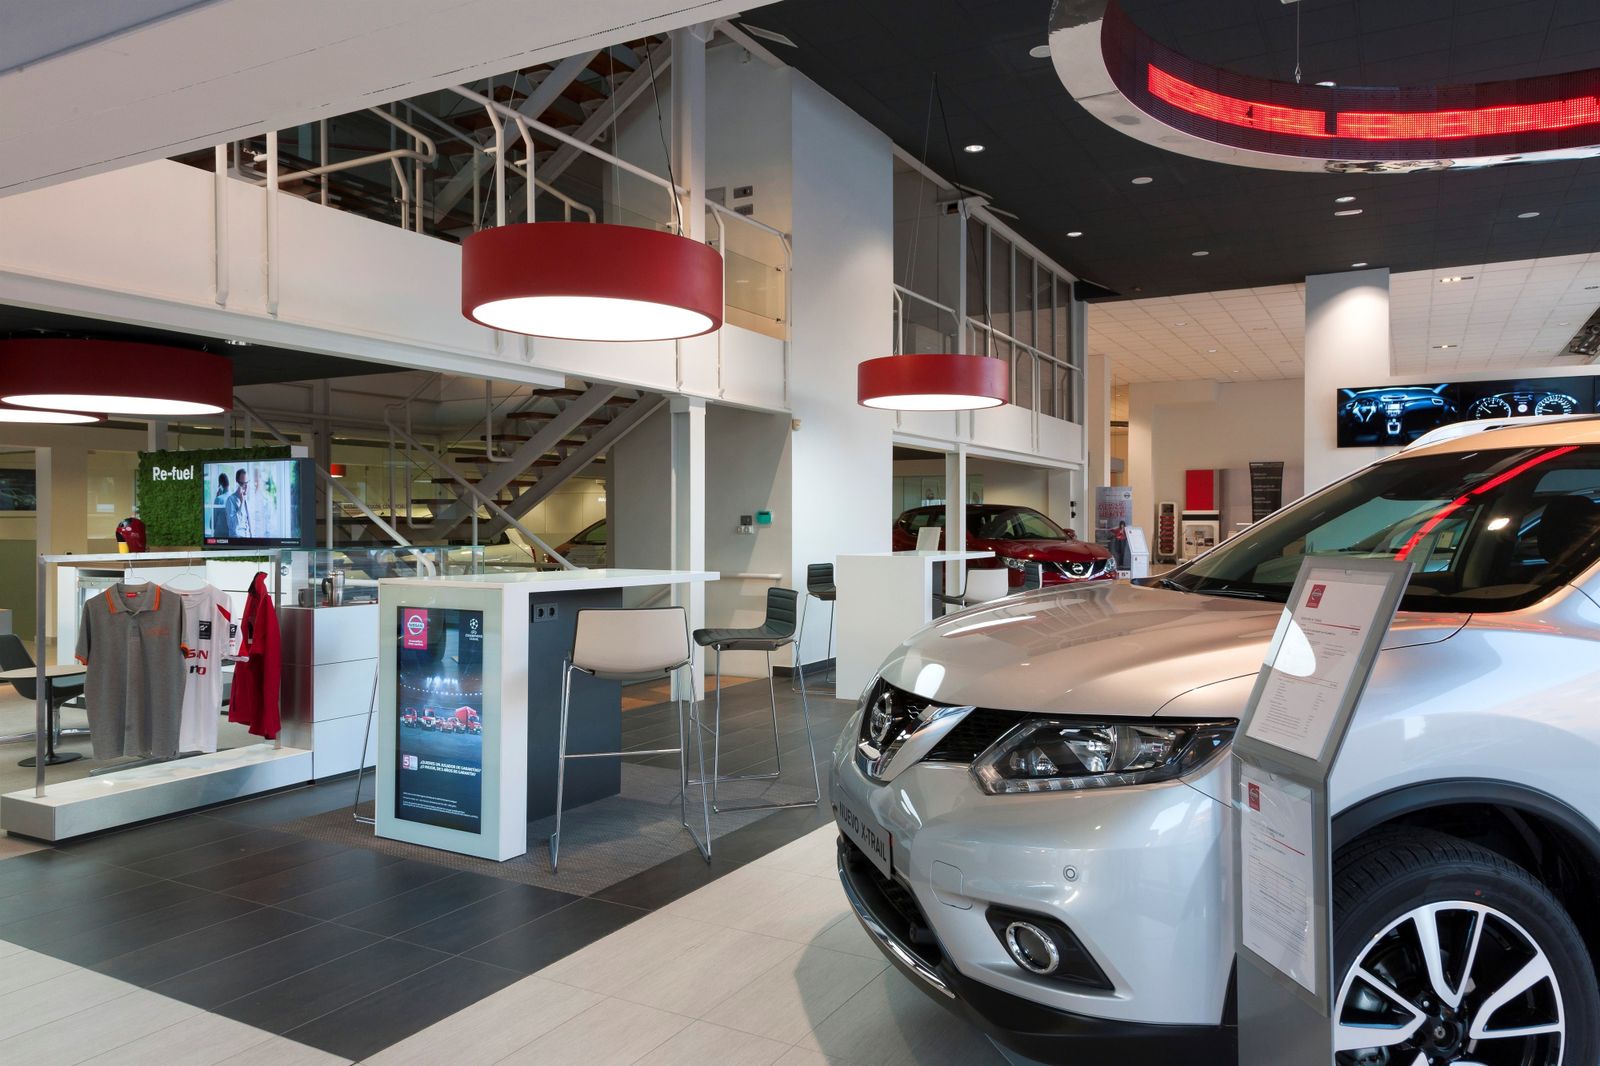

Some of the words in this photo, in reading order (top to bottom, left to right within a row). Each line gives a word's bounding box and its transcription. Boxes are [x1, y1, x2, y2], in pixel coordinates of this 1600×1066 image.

[152, 465, 194, 481] Re-fuel
[403, 756, 409, 766] 5
[840, 801, 859, 834] NUEVO
[861, 822, 887, 861] X-TRAIL
